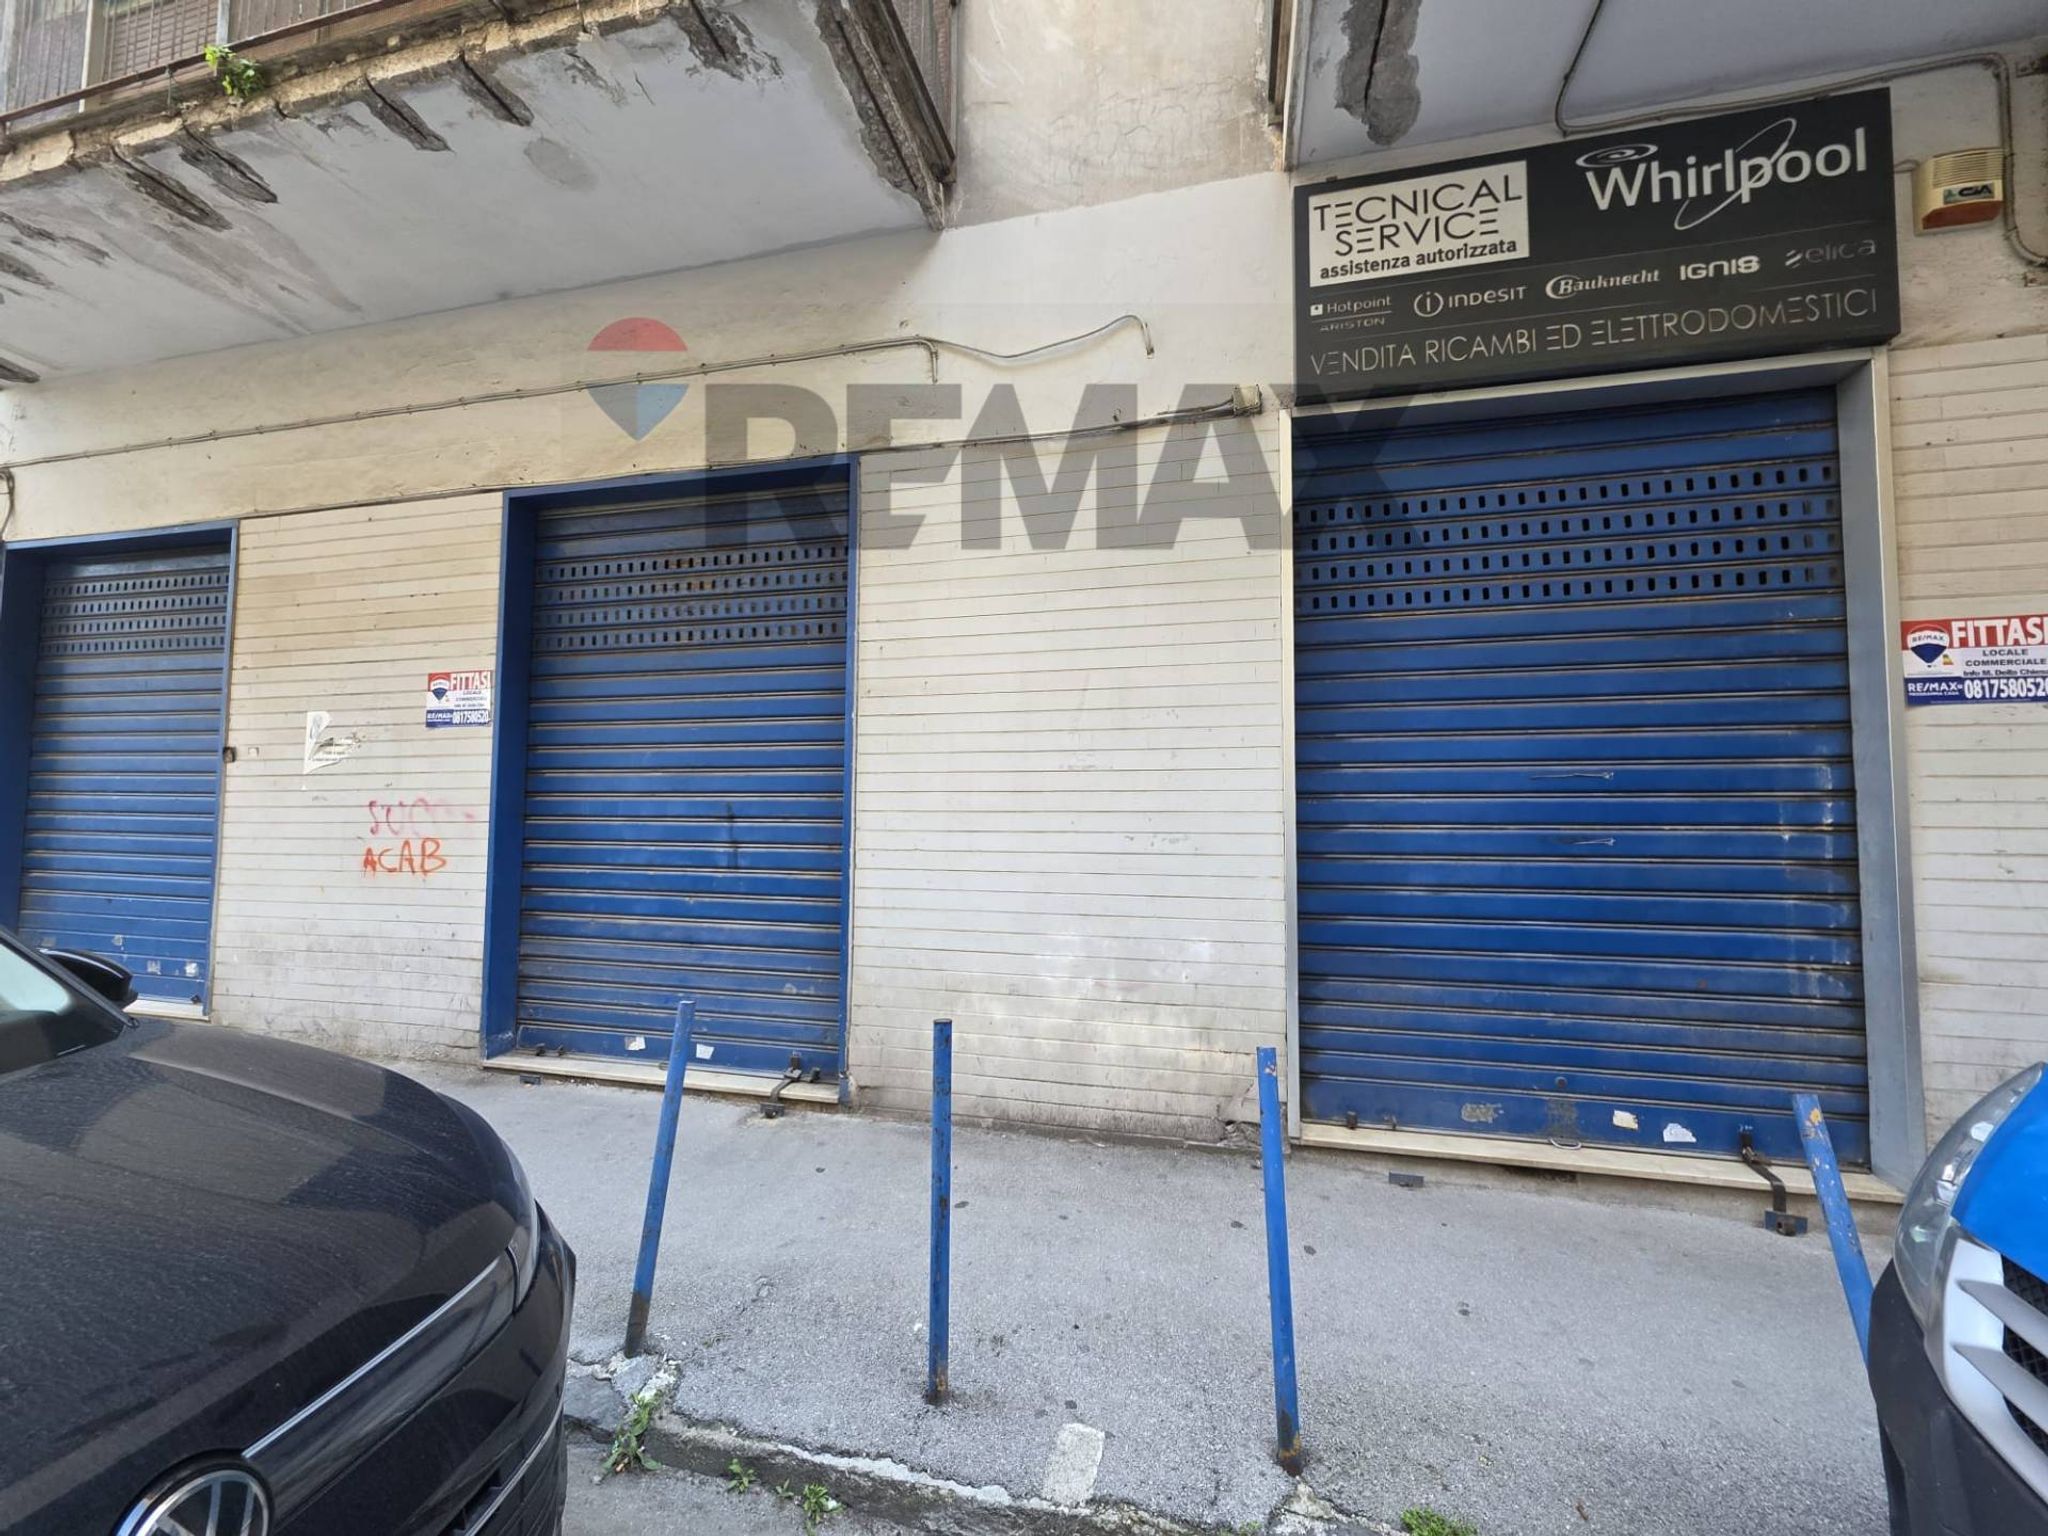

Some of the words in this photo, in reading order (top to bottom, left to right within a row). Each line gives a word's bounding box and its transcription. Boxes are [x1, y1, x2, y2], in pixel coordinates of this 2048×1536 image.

[1585, 126, 1867, 210] Whirlpool
[1313, 174, 1523, 232] TECNICAL
[1334, 207, 1499, 257] SERVICE
[1320, 254, 1411, 280] assistenza
[1415, 239, 1518, 266] autorizzata
[1805, 239, 1877, 264] elica
[1557, 269, 1661, 296] Bauknecht
[1326, 295, 1393, 315] Hotpoint
[1310, 343, 1417, 376] VENDITA
[1424, 328, 1537, 364] RICAMBI
[1545, 323, 1582, 351] ED
[1590, 287, 1877, 347] ELETTRODOMESTICI
[1319, 316, 1386, 333] ARISTON
[1965, 658, 2048, 667] COMMERCIALE
[1982, 648, 2029, 657] LOCALE
[450, 671, 491, 691] FITTASI
[362, 837, 448, 877] ACAB
